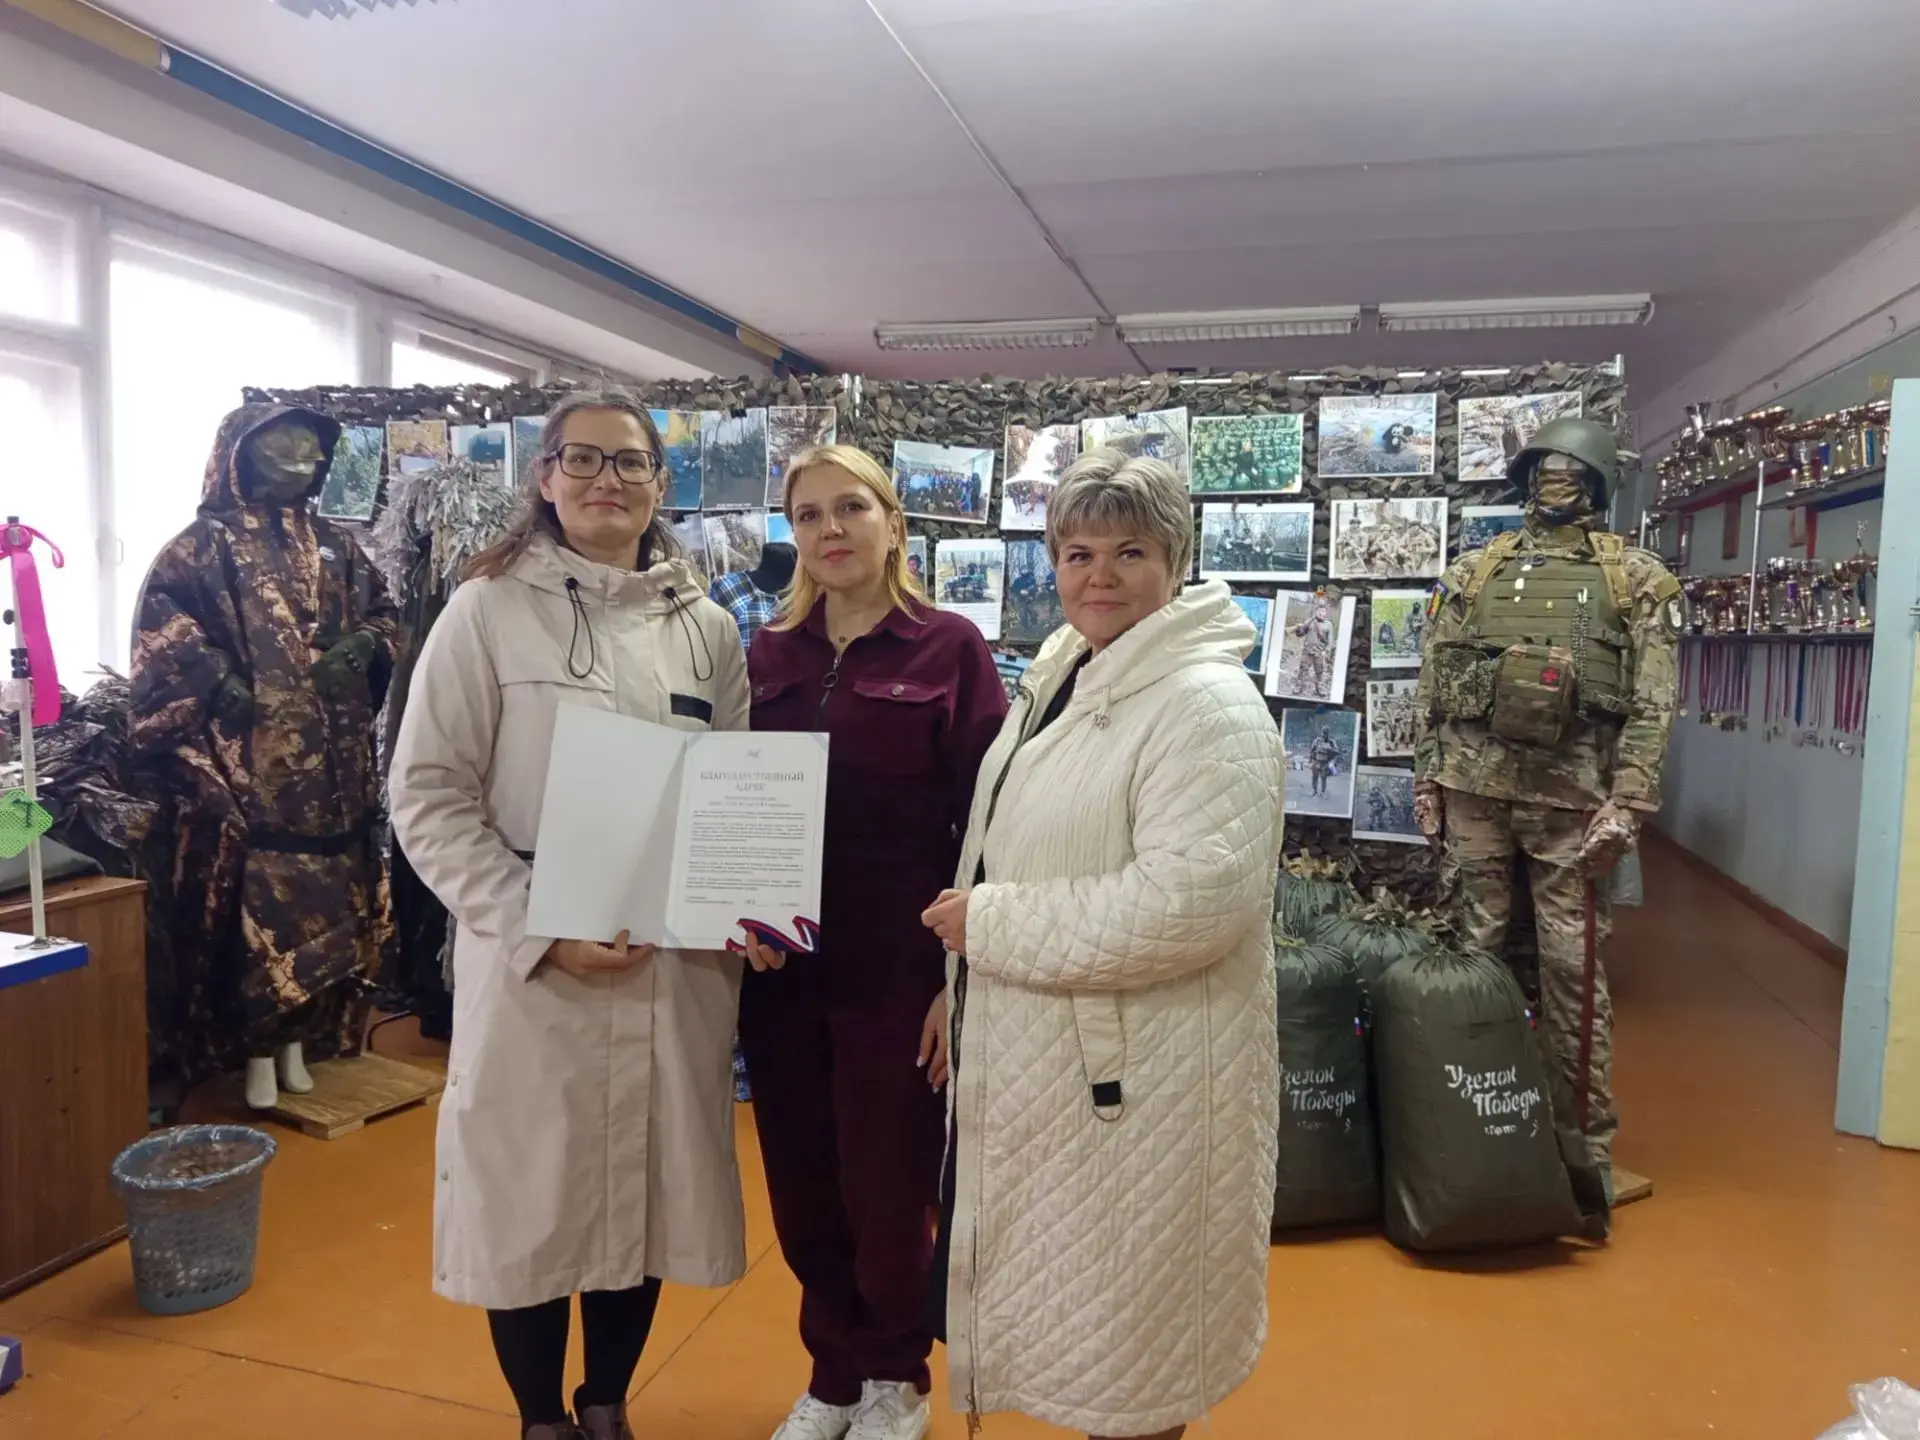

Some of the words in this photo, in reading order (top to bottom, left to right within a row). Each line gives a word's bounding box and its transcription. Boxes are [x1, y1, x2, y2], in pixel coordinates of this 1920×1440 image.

[1444, 1064, 1517, 1098] Узелок
[1289, 1088, 1356, 1117] Победы
[1472, 1086, 1541, 1120] Победы
